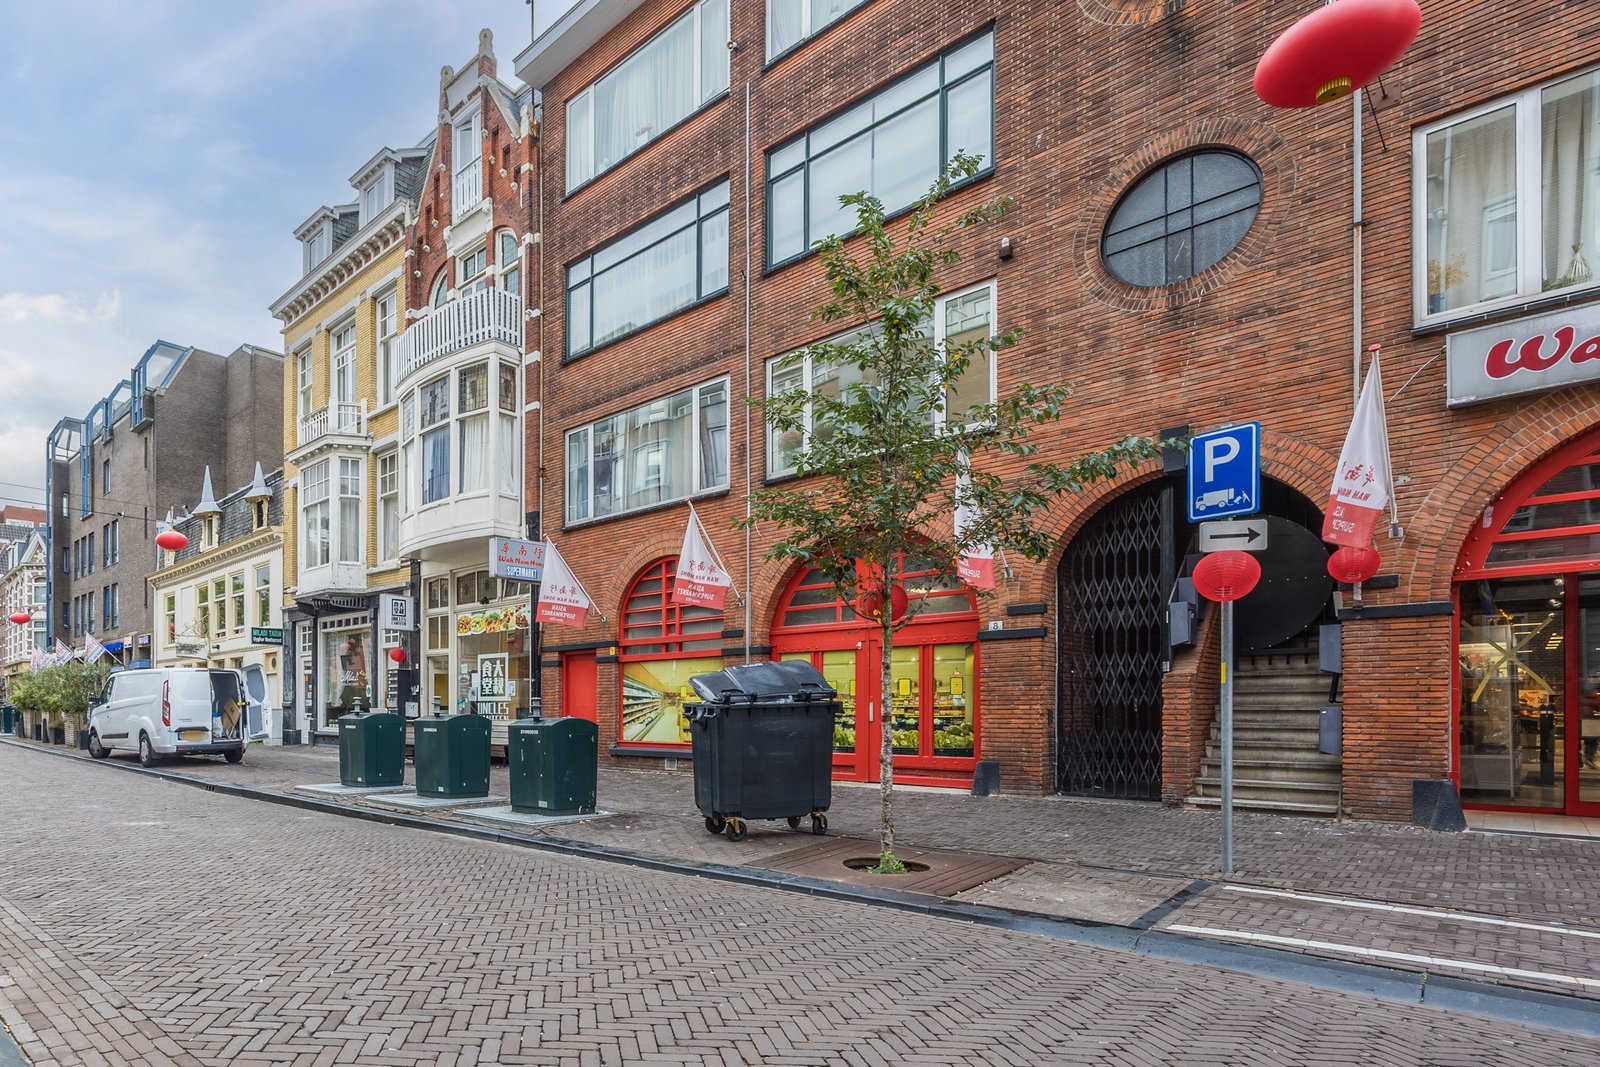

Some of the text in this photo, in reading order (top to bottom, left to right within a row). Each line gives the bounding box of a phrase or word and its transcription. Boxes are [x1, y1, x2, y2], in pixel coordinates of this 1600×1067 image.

[1204, 436, 1240, 483] P
[498, 555, 514, 563] Wah
[514, 557, 530, 565] Nam
[507, 565, 537, 579] SUPERMARKT
[477, 702, 509, 715] UNCLES
